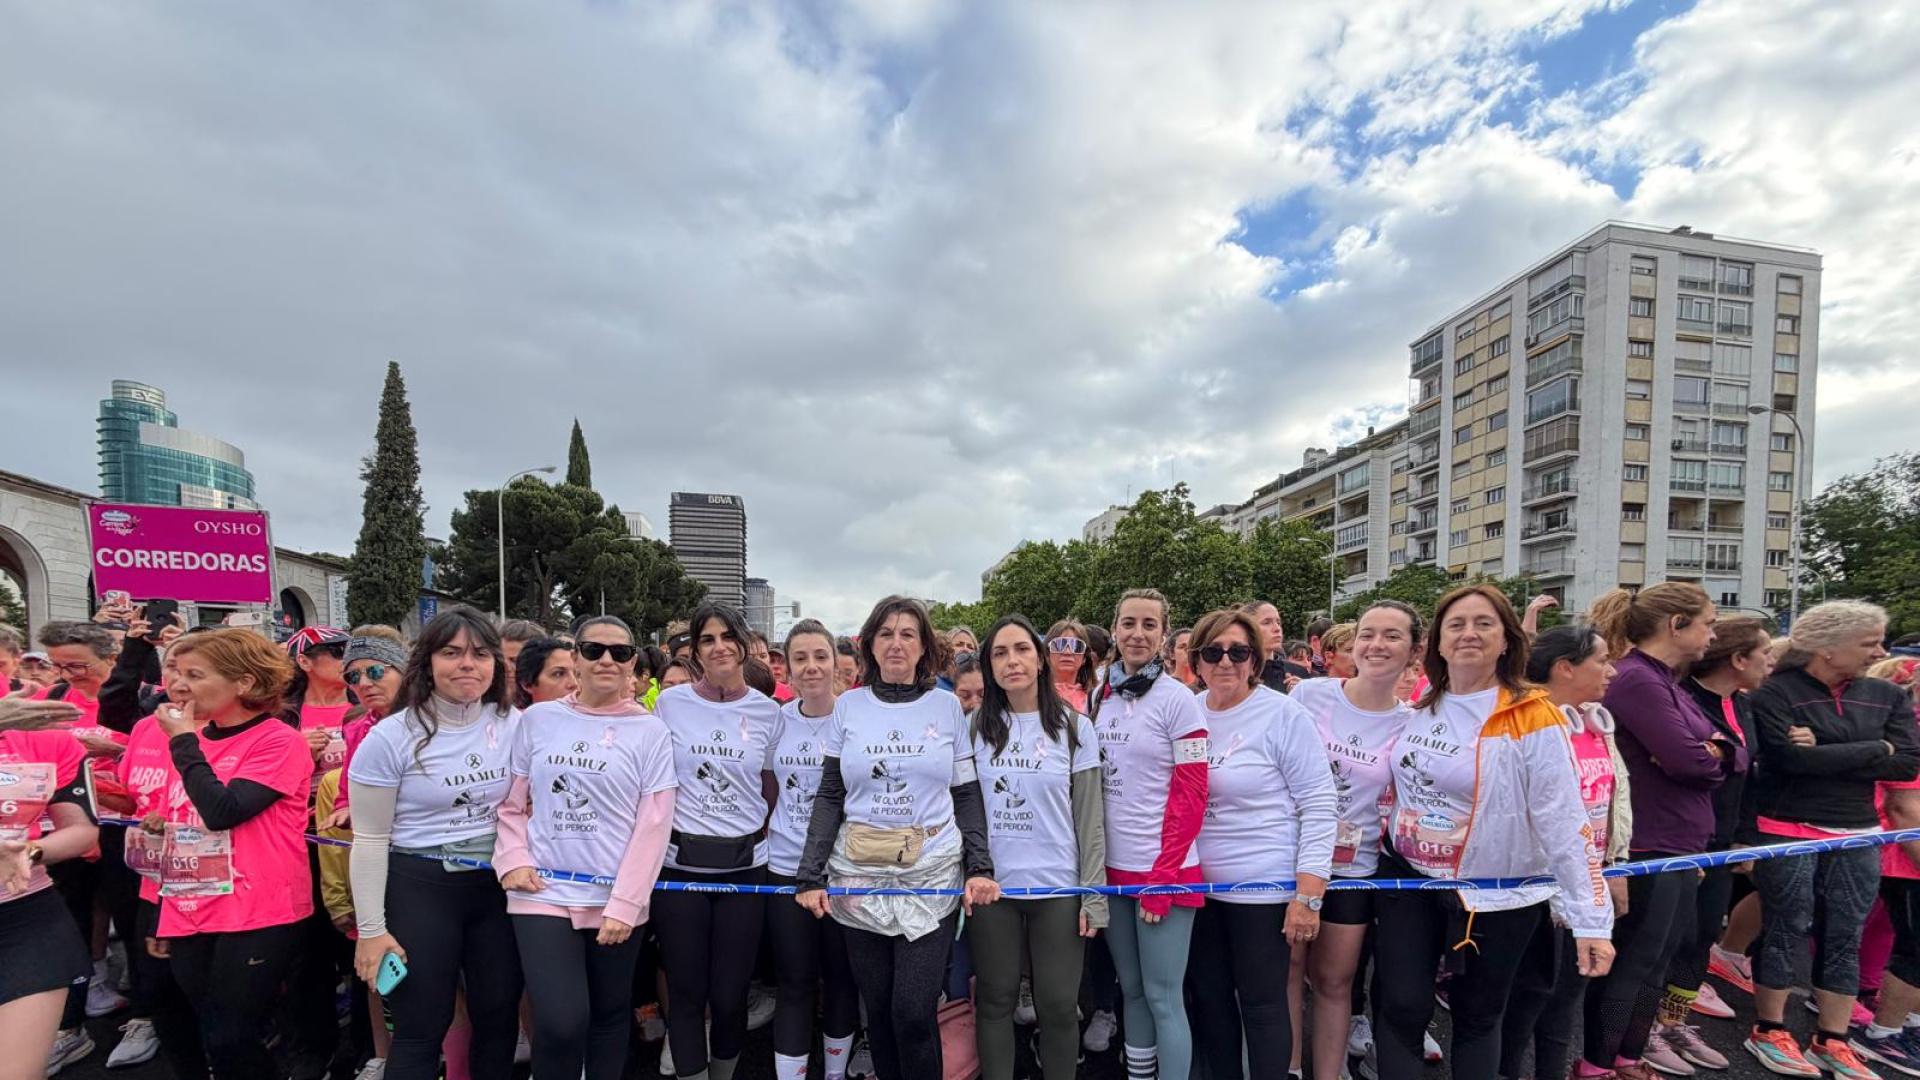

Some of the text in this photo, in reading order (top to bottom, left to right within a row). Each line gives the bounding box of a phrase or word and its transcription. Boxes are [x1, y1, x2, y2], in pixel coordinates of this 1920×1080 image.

[131, 389, 152, 401] EY
[708, 495, 732, 505] BBVA
[194, 520, 261, 535] OYSHO
[95, 547, 267, 573] CORREDORAS
[689, 744, 745, 759] ADAMUZ
[863, 744, 926, 755] ADAMUZ
[1326, 742, 1378, 764] ADAMUZ
[324, 751, 343, 763] 01
[543, 754, 608, 773] ADAMUZ
[989, 757, 1043, 770] ADAMUZ
[128, 766, 168, 786] CARR
[440, 767, 507, 788] ADAMUZ
[882, 793, 914, 805] OLVIDO
[564, 810, 599, 823] OLVIDO
[881, 805, 913, 816] PERDÓN
[1002, 810, 1034, 821] OLVIDO
[1002, 821, 1033, 832] PERDÓN
[1418, 840, 1454, 856] 016
[147, 850, 162, 861] 01
[173, 856, 199, 870] 016
